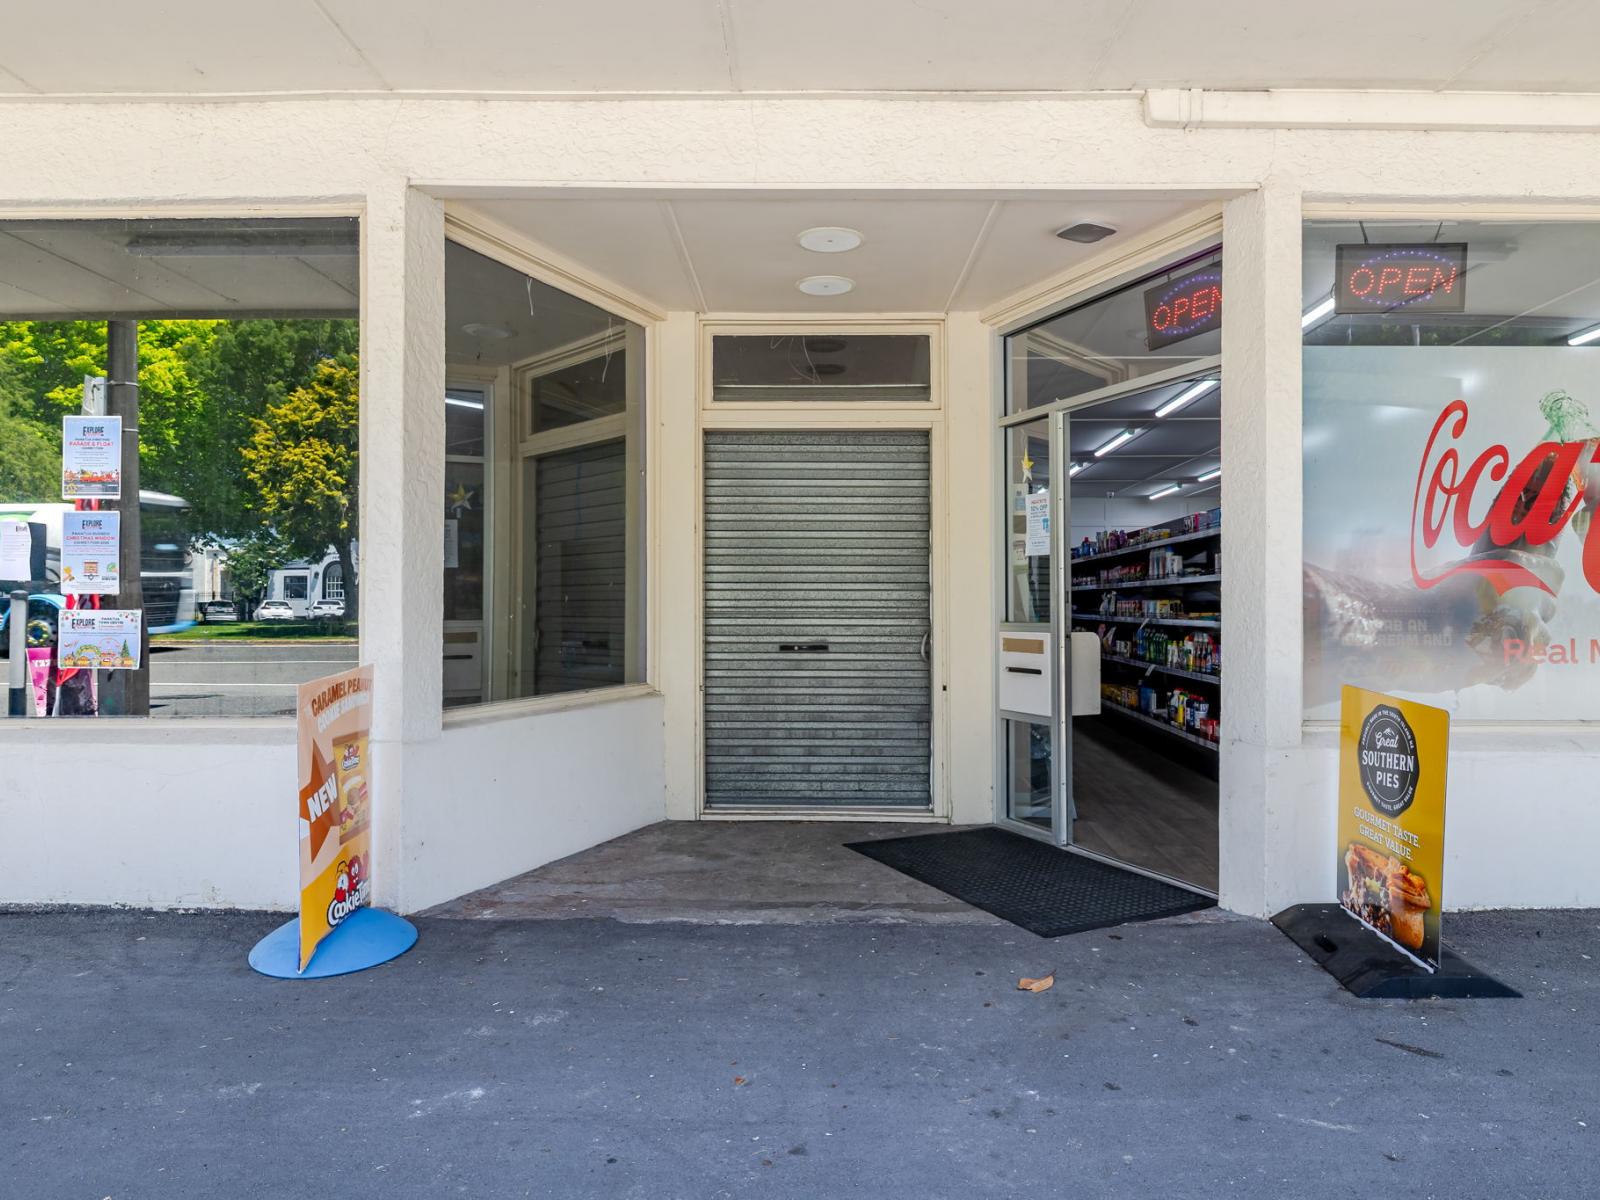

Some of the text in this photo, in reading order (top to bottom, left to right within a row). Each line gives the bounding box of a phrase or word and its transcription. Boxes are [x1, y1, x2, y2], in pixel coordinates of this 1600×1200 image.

[1350, 266, 1457, 296] OPEN
[82, 425, 105, 437] EXPLORE
[1411, 400, 1586, 590] Coca
[82, 519, 103, 530] EXPLORE
[71, 618, 96, 630] EXPLORE
[1503, 638, 1579, 665] Real
[311, 681, 347, 717] CARAMEL
[1375, 731, 1399, 749] Great
[1362, 749, 1415, 772] SOUTHERN
[1376, 770, 1400, 789] PIES
[307, 772, 338, 824] NEW
[1353, 806, 1421, 849] GOURMET TASTE.
[1359, 824, 1384, 845] GREAT
